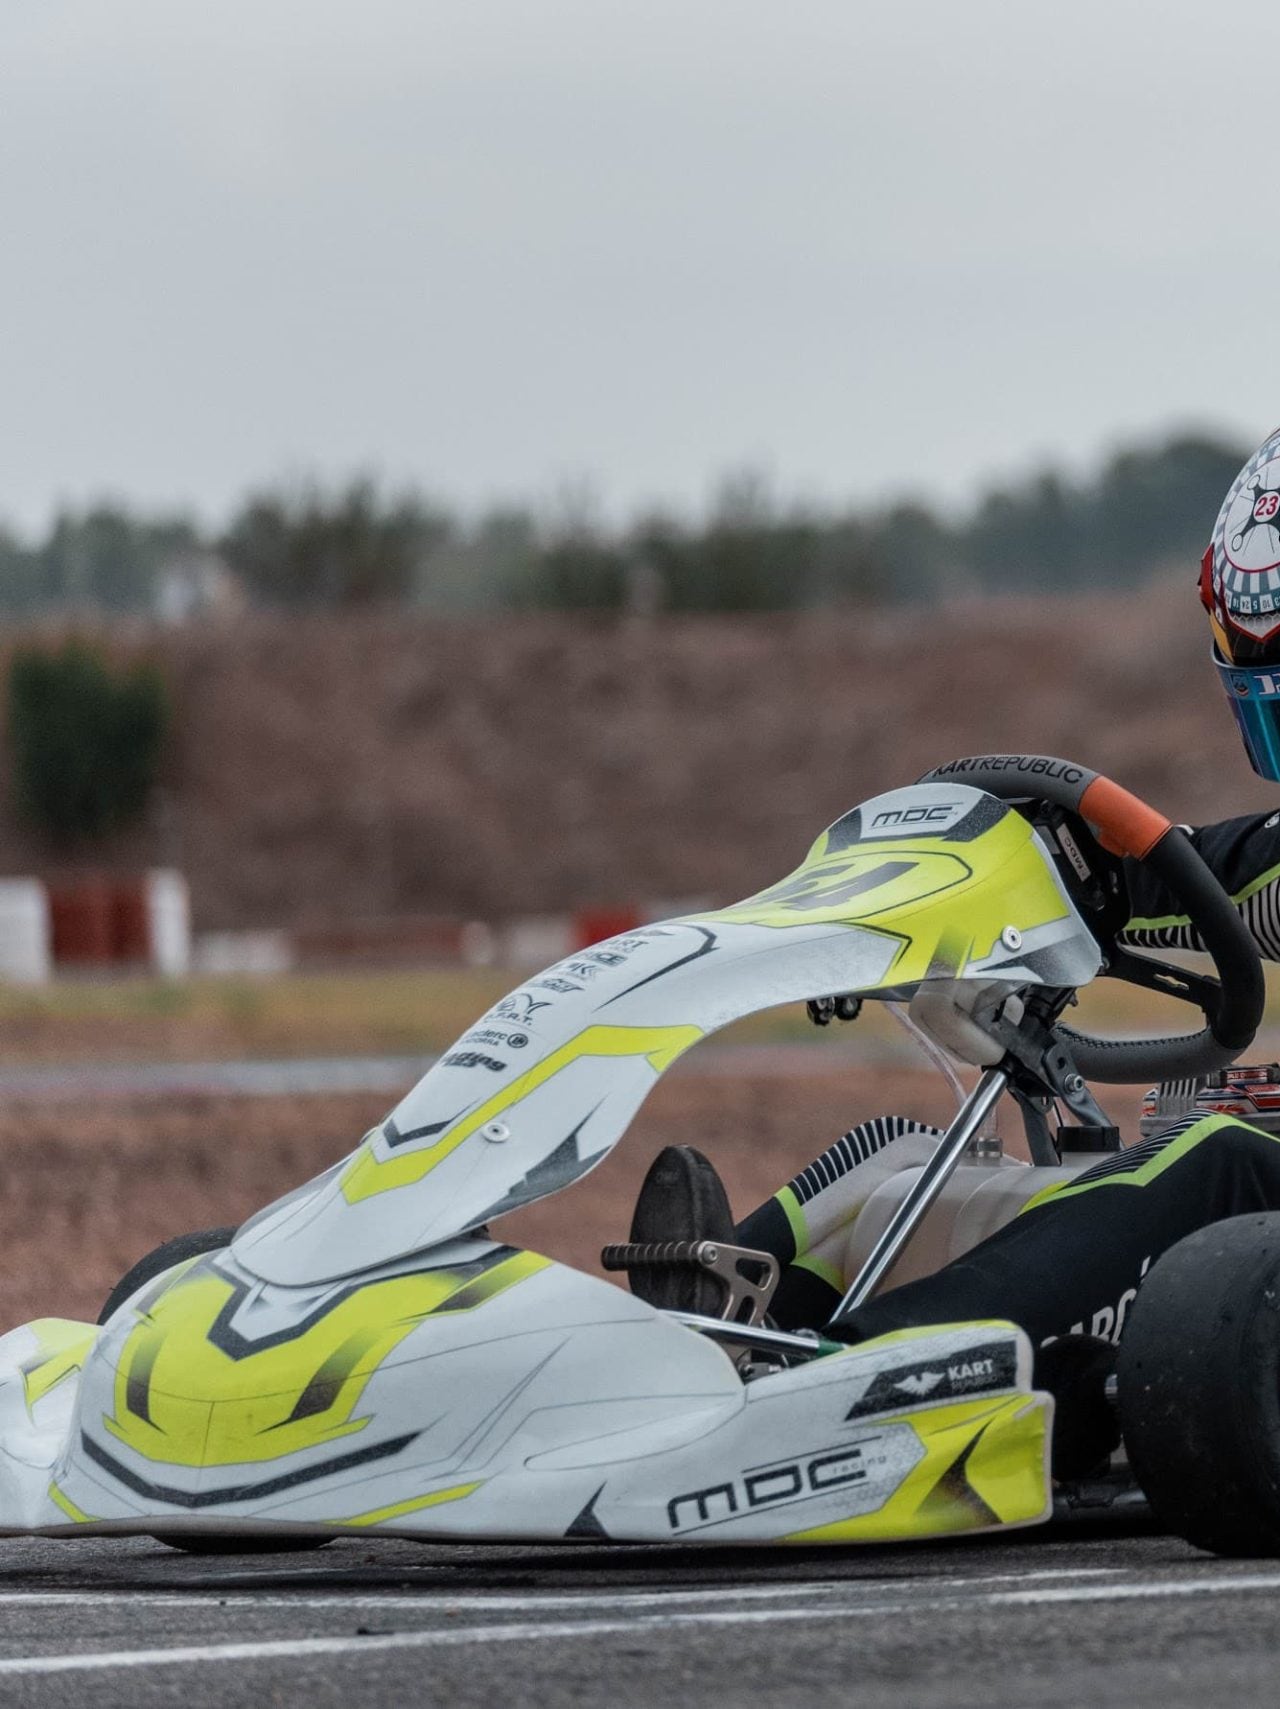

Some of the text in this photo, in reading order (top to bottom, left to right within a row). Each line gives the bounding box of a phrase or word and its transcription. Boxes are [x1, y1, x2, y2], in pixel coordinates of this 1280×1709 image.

[1255, 495, 1280, 517] 23
[871, 806, 953, 827] MDC
[948, 1359, 994, 1381] KART
[666, 1449, 887, 1529] MDC racing
